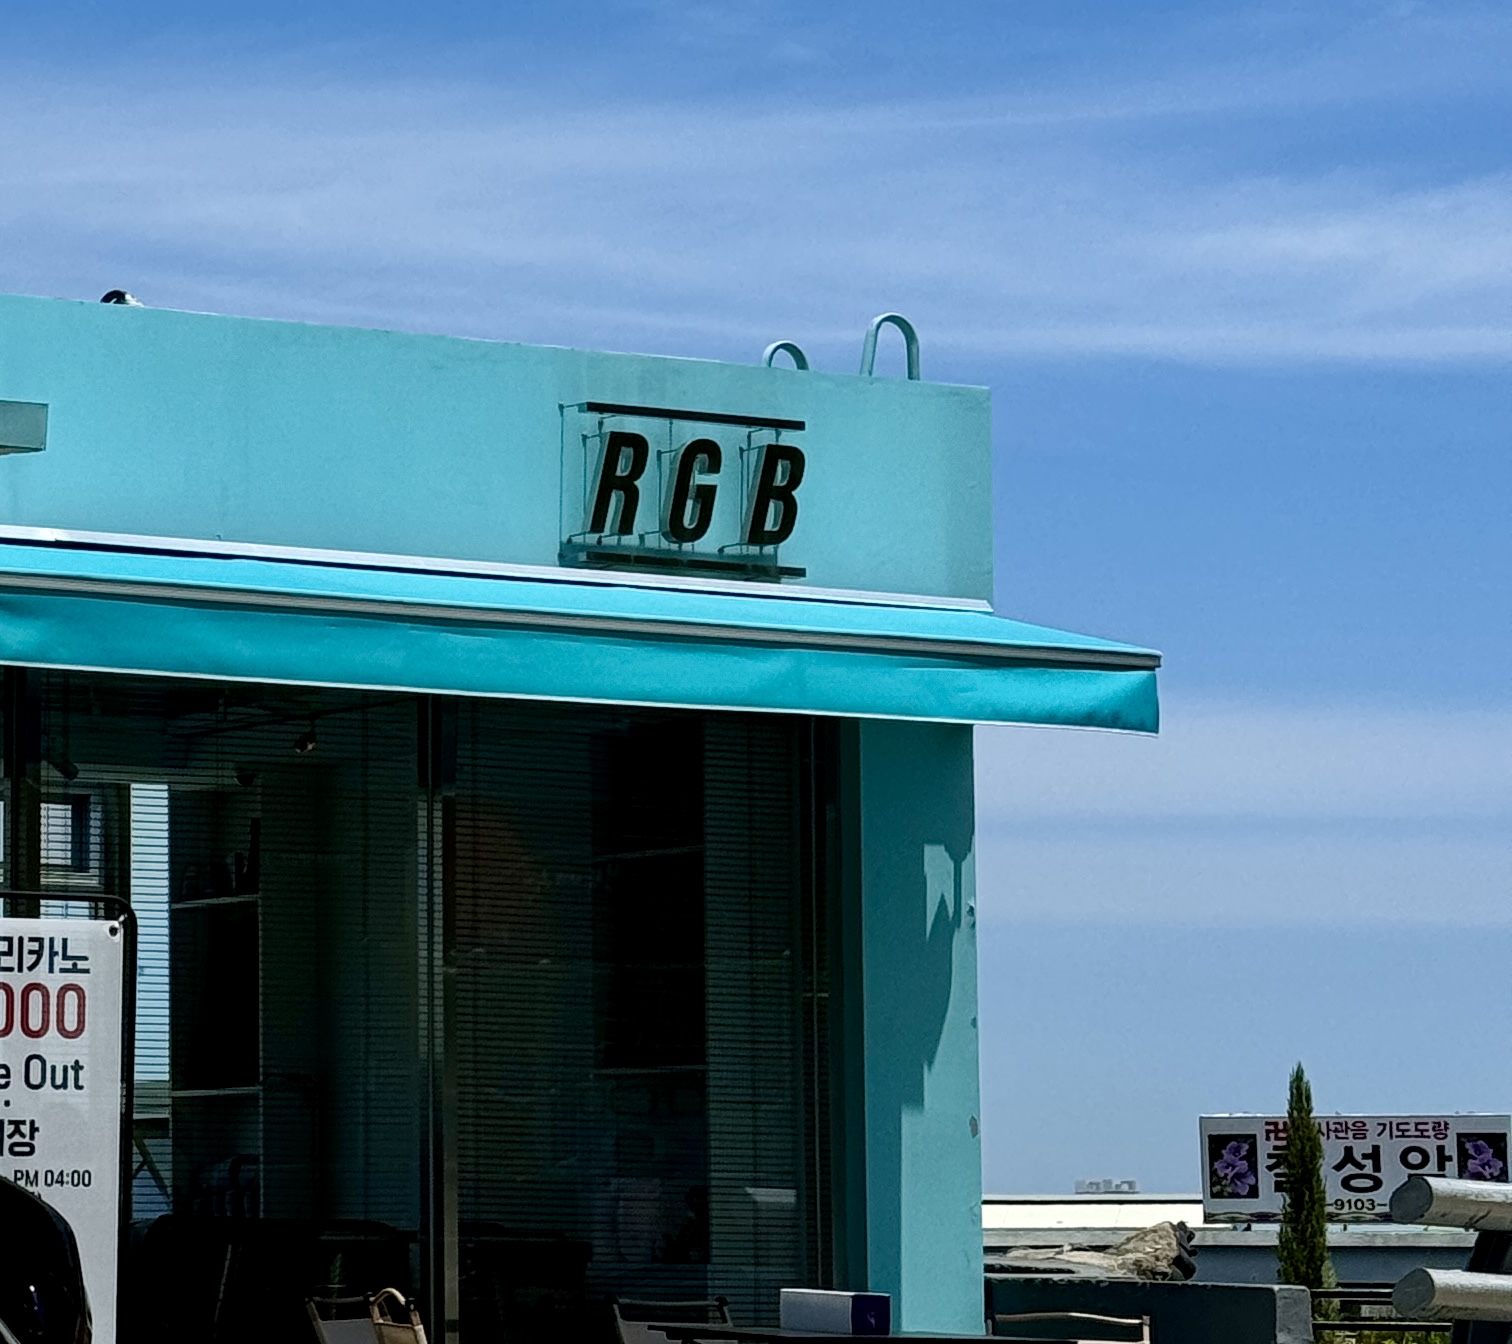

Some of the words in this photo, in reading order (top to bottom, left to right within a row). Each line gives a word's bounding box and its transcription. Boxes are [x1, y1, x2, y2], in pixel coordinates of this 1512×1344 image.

[585, 430, 806, 545] RGB
[23, 1054, 85, 1091] Out
[1376, 1120, 1450, 1141] 기도도량
[13, 1169, 39, 1187] PM
[44, 1169, 92, 1188] 04:00
